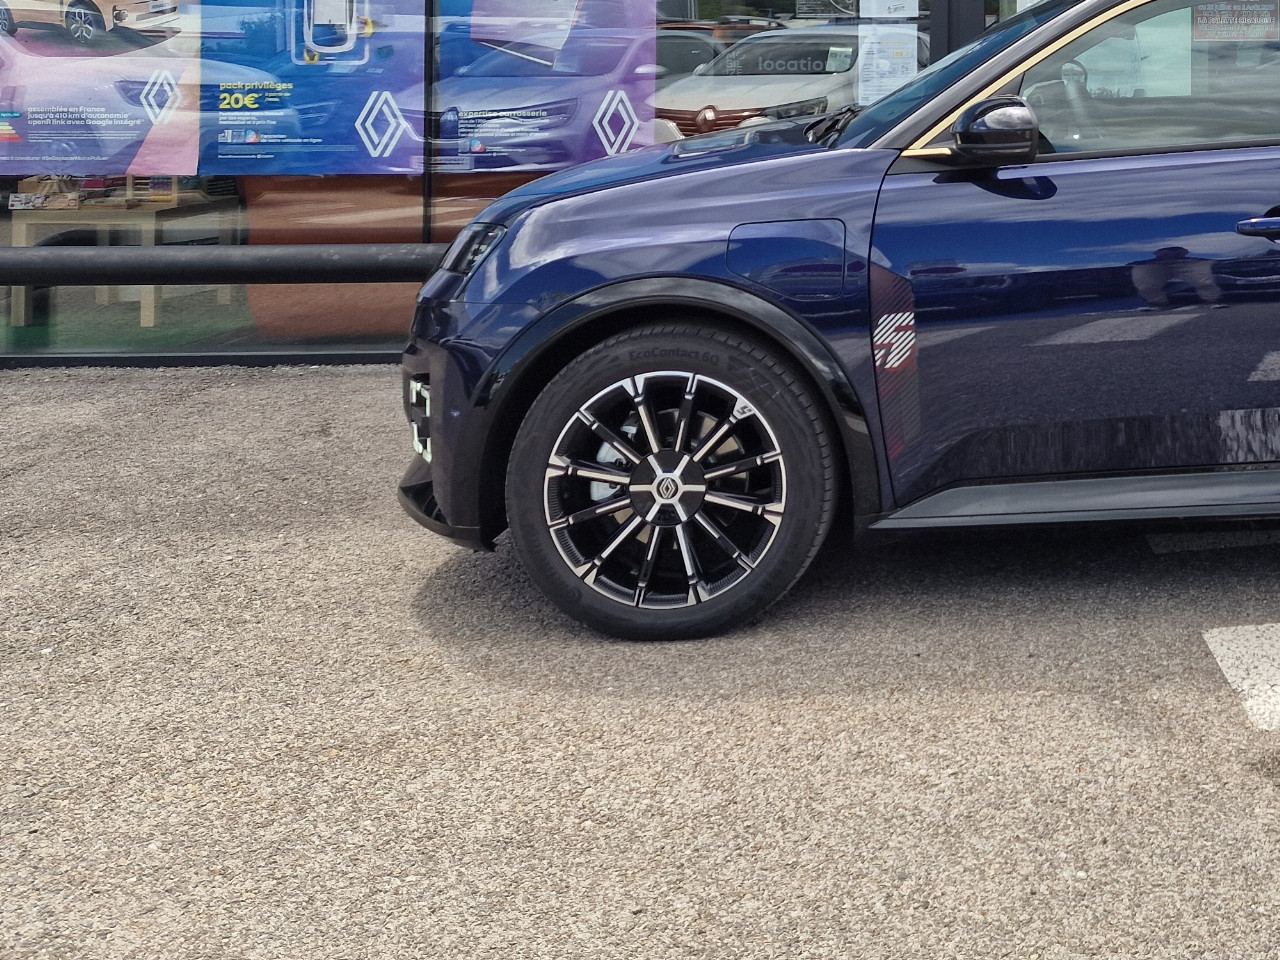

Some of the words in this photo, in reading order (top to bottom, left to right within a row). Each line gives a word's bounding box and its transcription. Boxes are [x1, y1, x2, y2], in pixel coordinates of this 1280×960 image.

[758, 57, 827, 71] locatio
[220, 82, 244, 90] pack
[245, 82, 294, 91] privilèges
[458, 110, 498, 118] expertise
[500, 109, 548, 117] carrosserie
